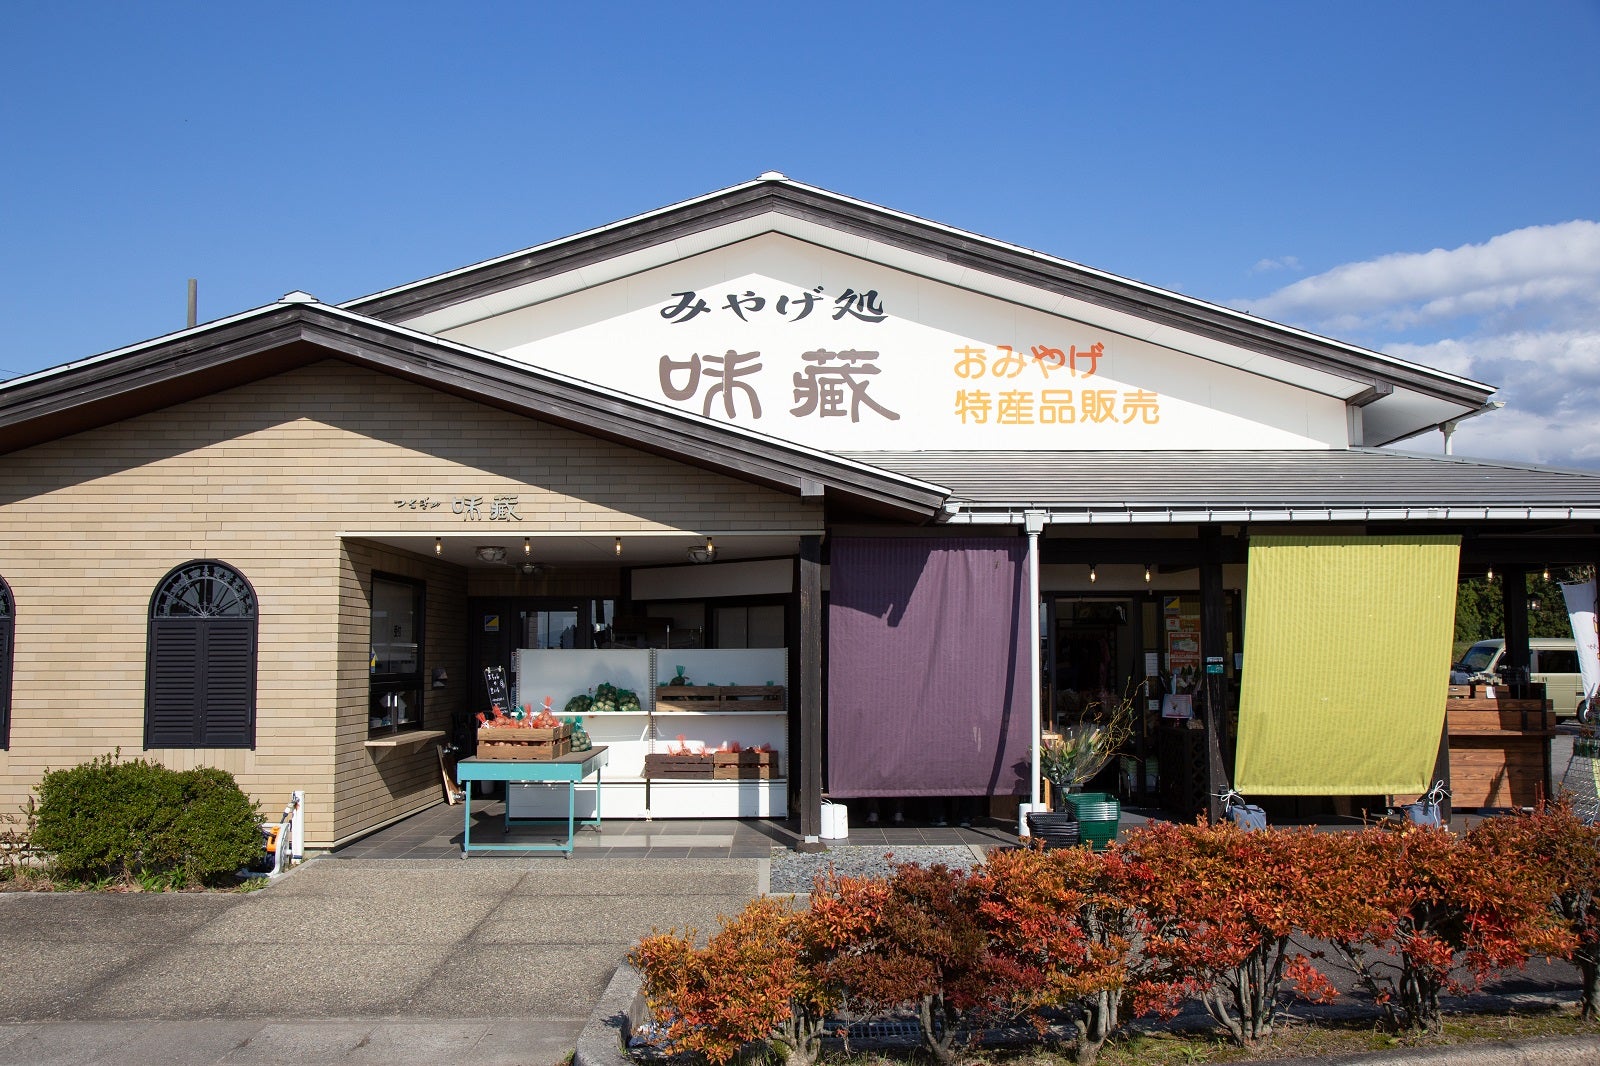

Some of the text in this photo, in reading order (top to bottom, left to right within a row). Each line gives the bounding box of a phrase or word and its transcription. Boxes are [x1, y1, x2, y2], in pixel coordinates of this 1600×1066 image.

[660, 286, 889, 323] みやげ処
[953, 342, 1105, 379] おみやげ
[955, 389, 1160, 424] 特産品販売
